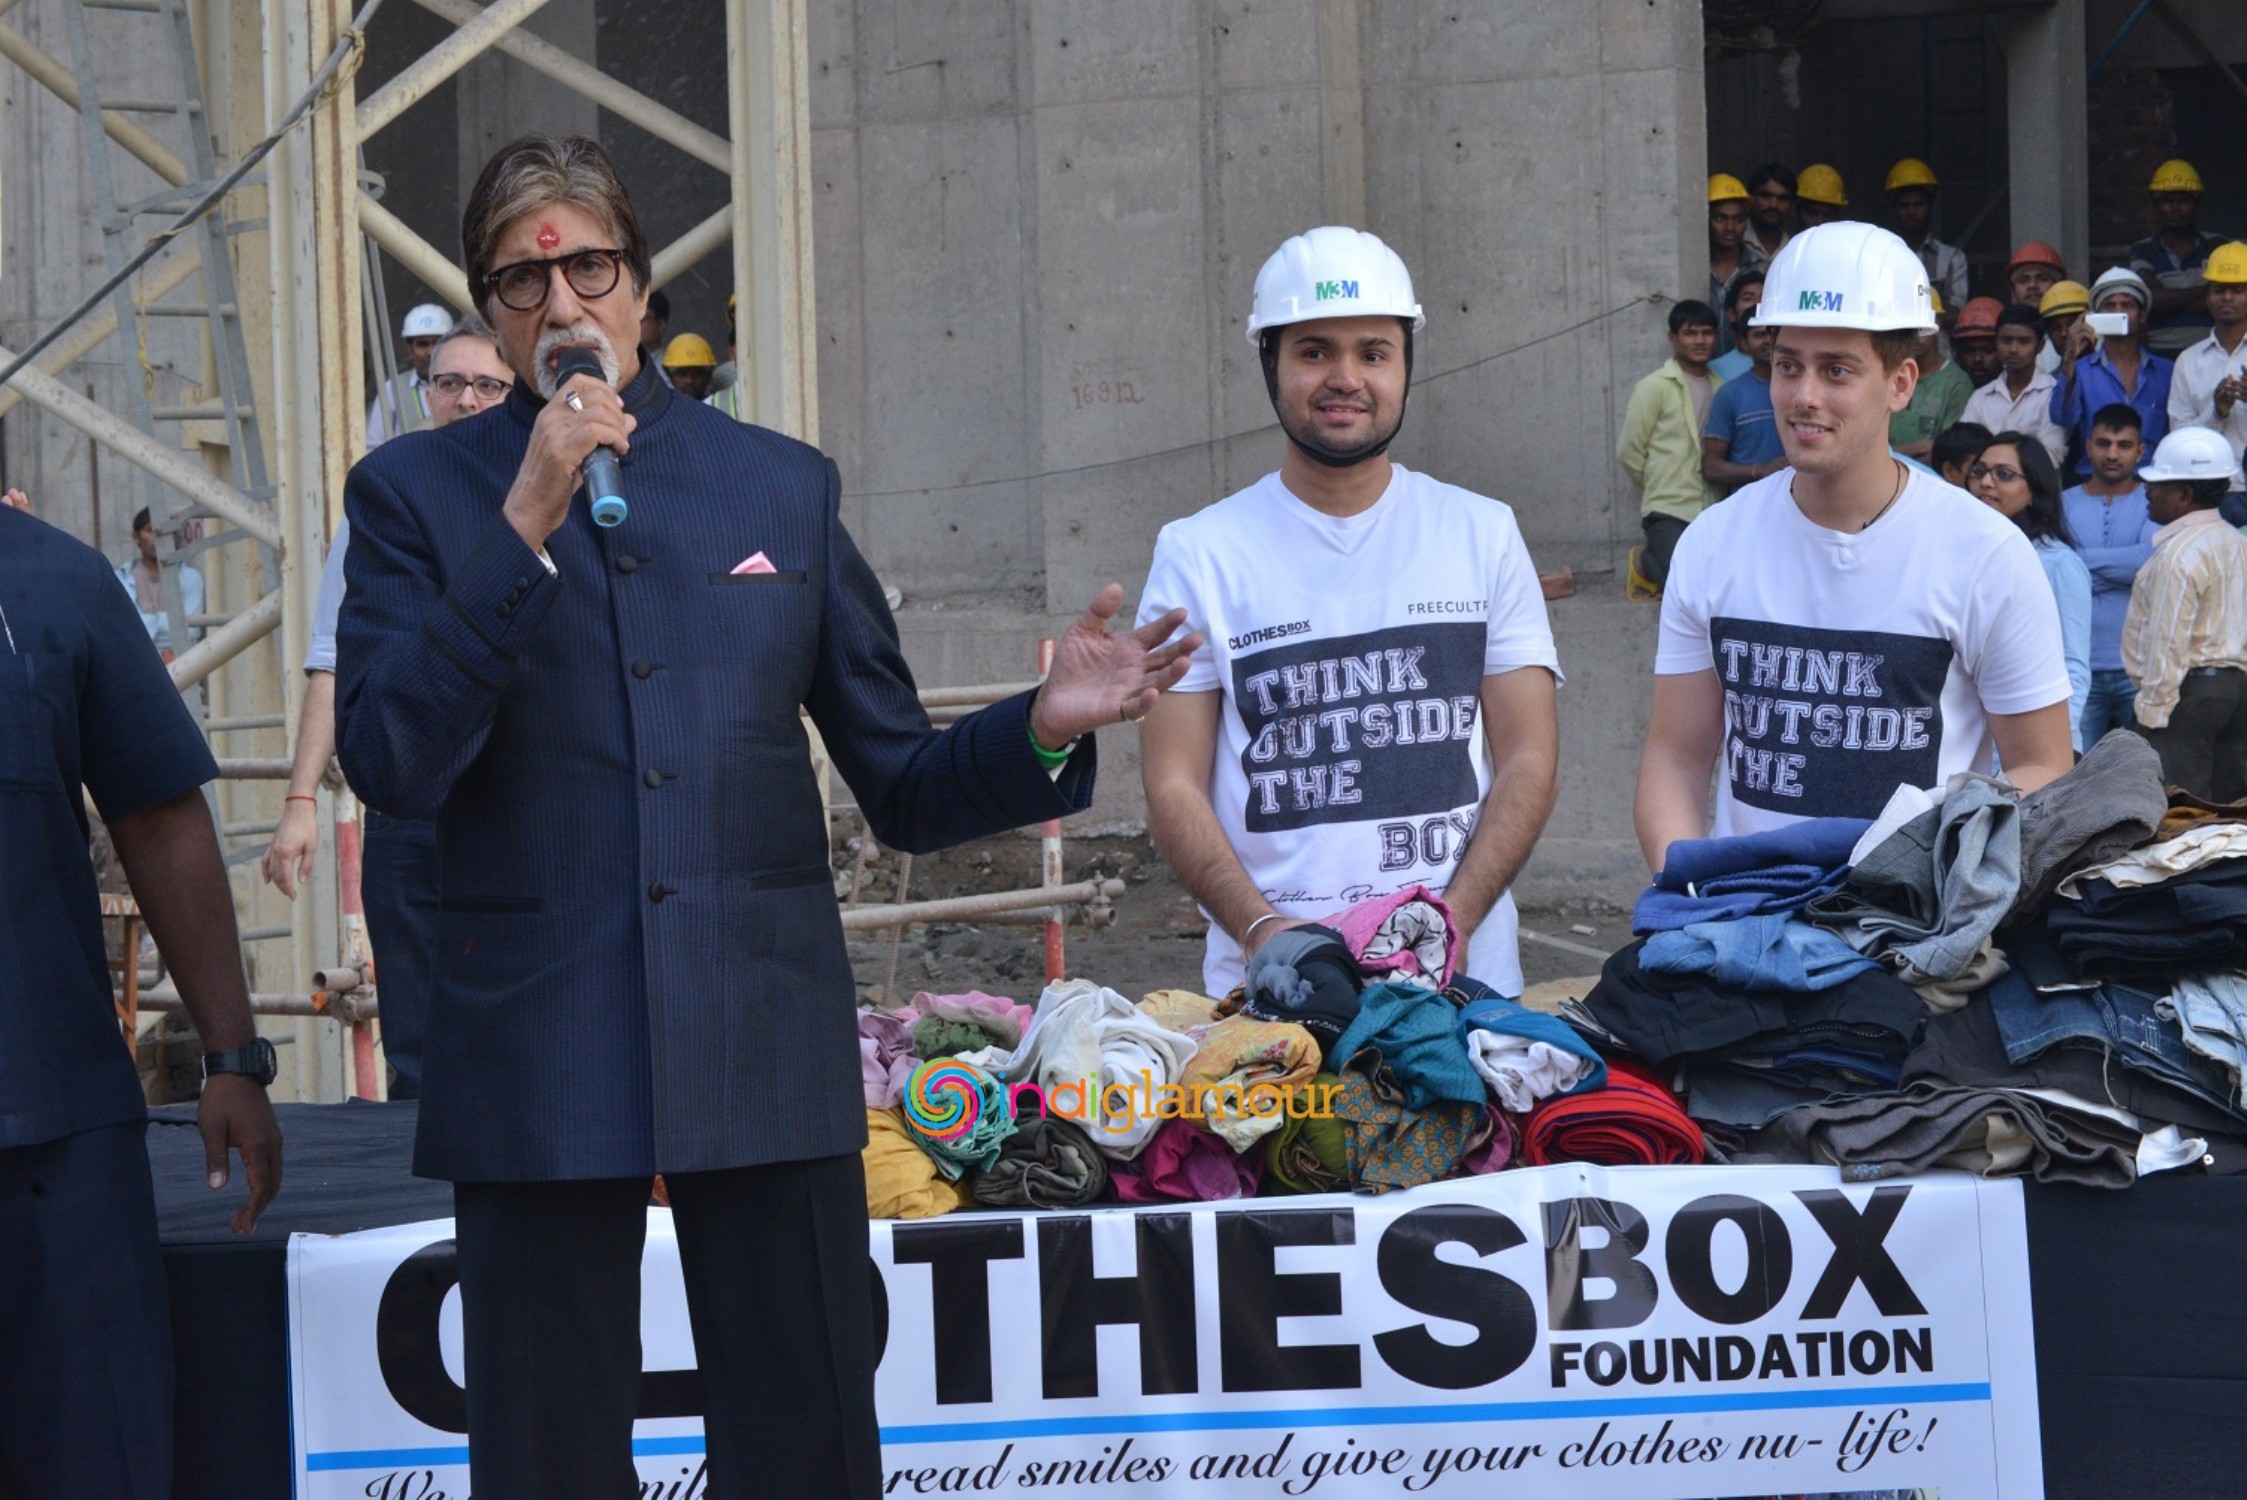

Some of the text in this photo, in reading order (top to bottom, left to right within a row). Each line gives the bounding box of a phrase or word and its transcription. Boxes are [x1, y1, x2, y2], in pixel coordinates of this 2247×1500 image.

[1316, 280, 1359, 301] M3M
[1799, 290, 1843, 312] M3M
[1246, 645, 1428, 716] THINK
[1720, 638, 1884, 698] THINK
[1249, 695, 1476, 763] OUTSIDE
[1251, 759, 1363, 815] THE
[1729, 737, 1807, 798] THE
[1549, 1327, 1934, 1389] FOUNDATION
[880, 1443, 1016, 1495] read
[1017, 1437, 1179, 1488] smiles
[1189, 1432, 1296, 1481] and
[1281, 1438, 1413, 1497] give
[1402, 1443, 1547, 1492] your
[1557, 1419, 1732, 1469] clothes
[1836, 1407, 1938, 1474] life!
